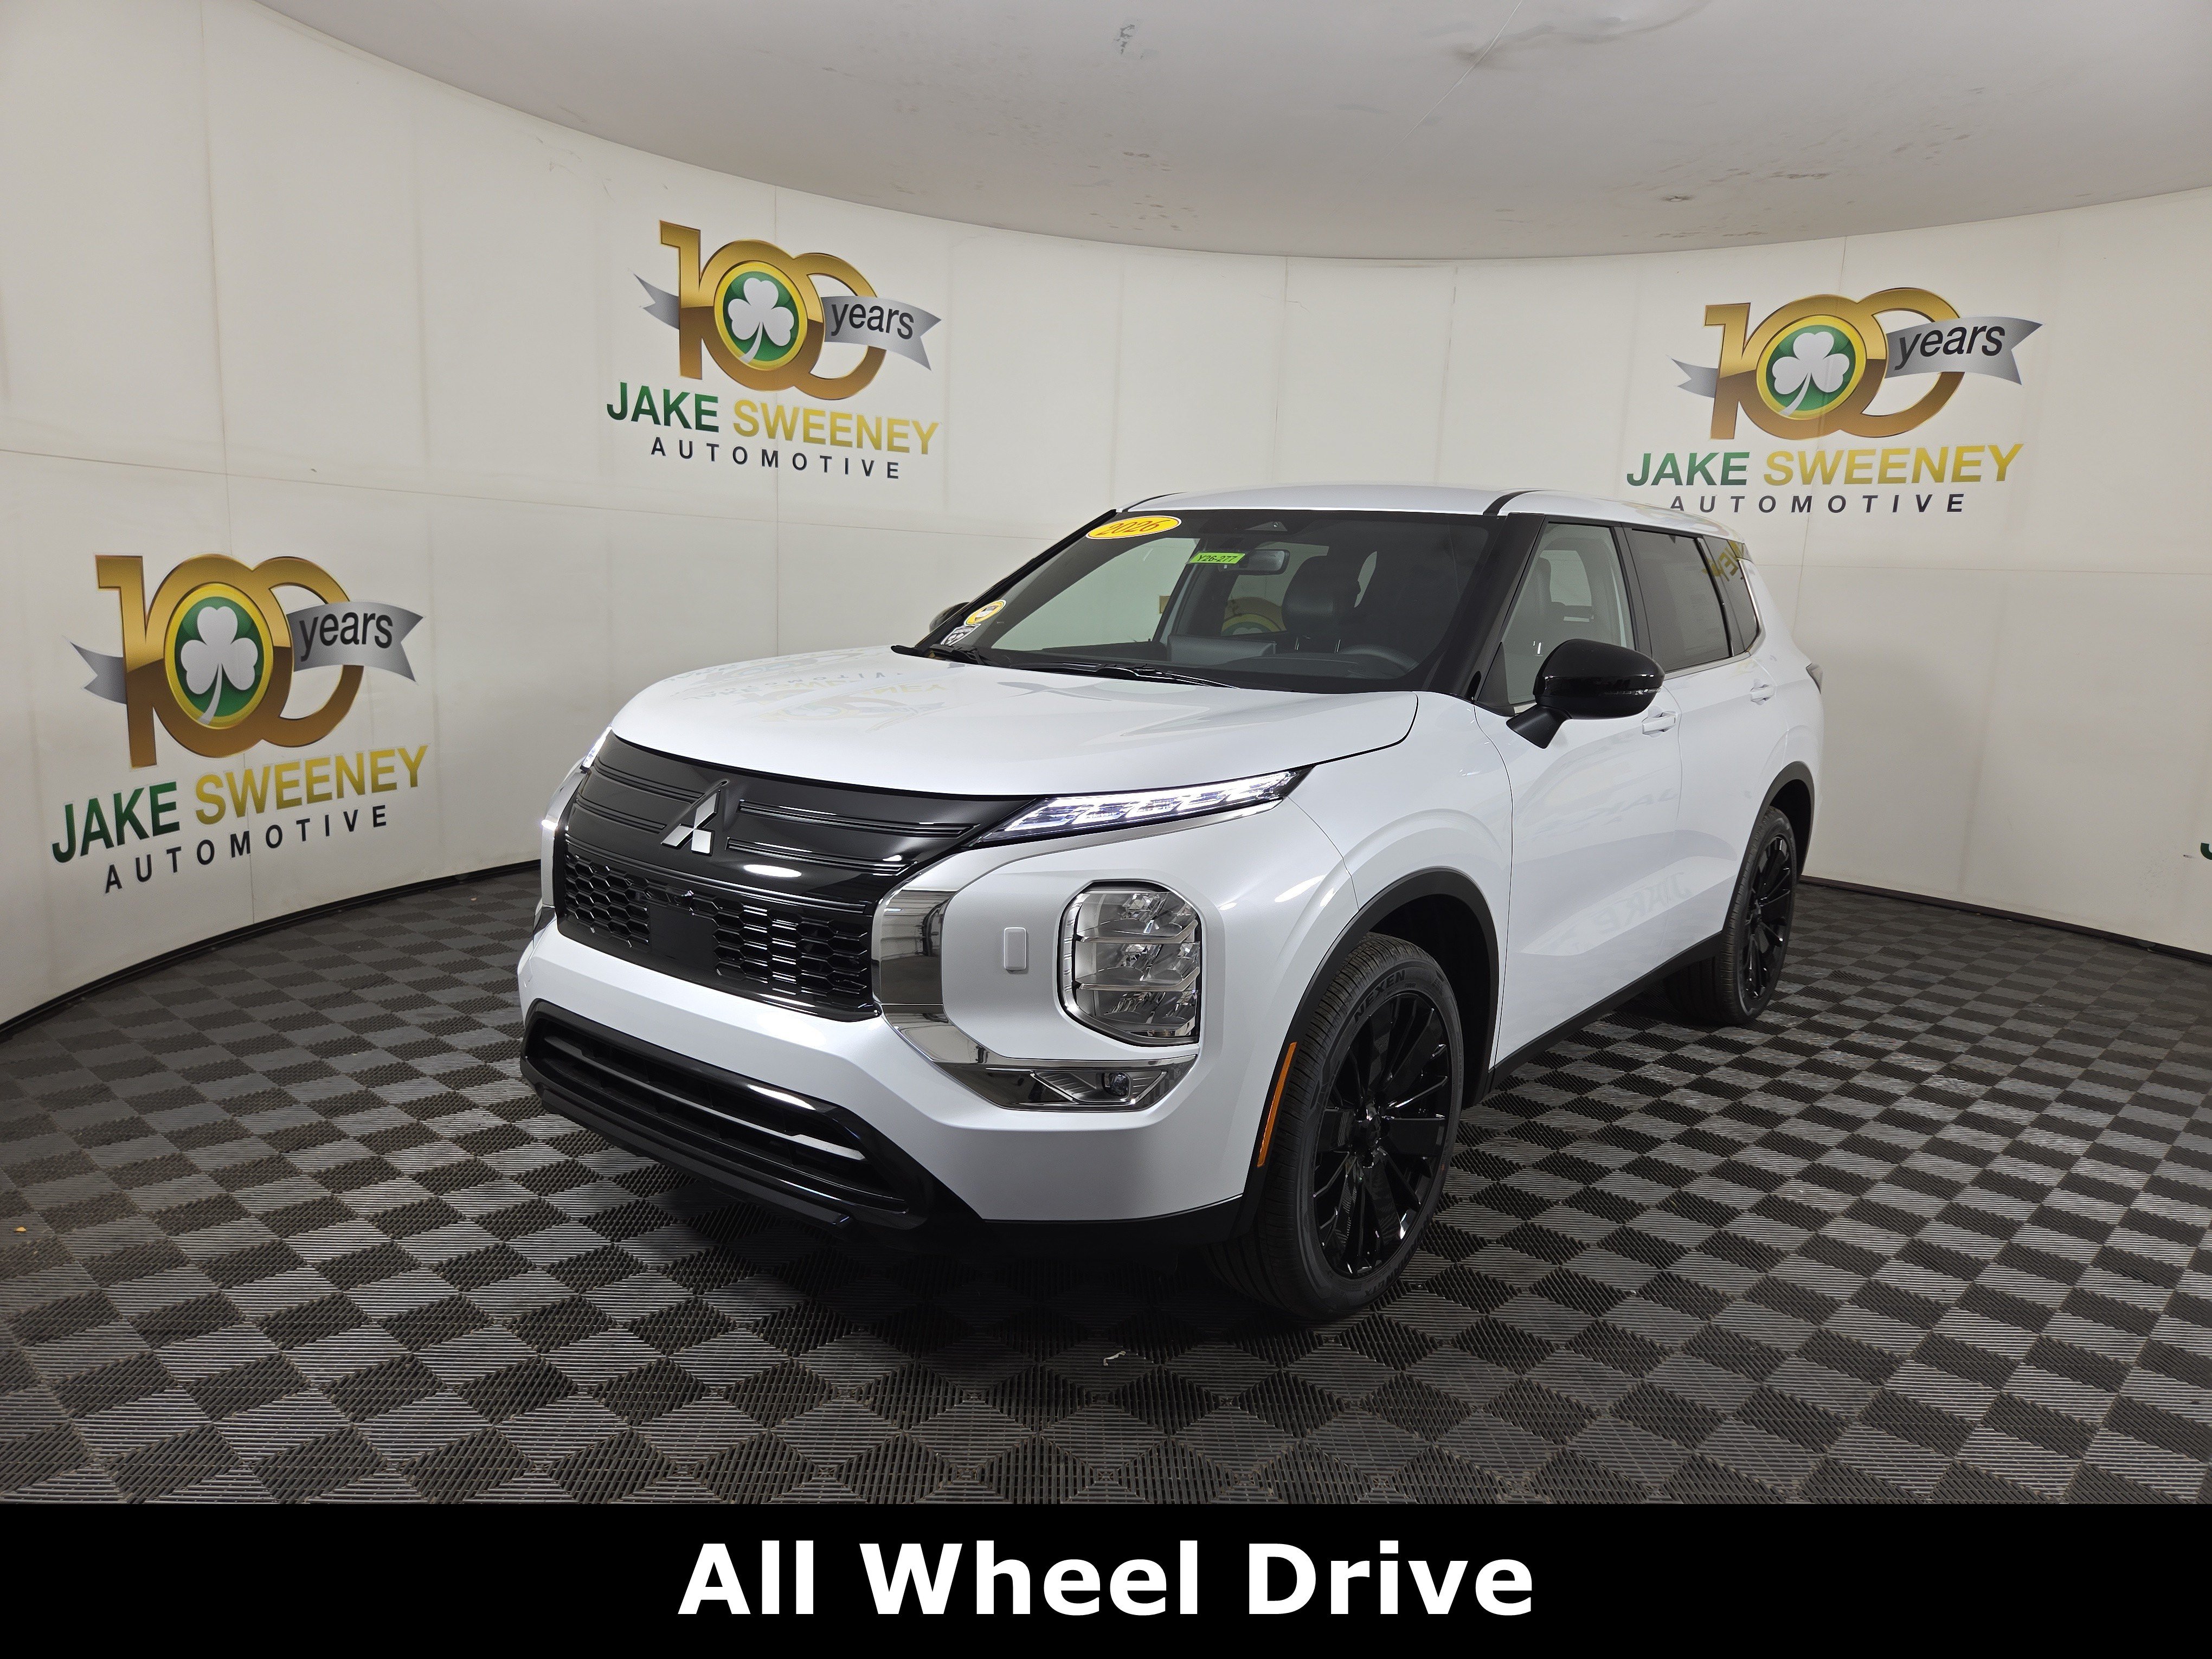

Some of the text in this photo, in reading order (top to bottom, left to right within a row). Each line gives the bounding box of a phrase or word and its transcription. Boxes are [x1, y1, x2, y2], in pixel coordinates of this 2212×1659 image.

[831, 300, 914, 340] years
[1894, 325, 2005, 370] years
[607, 382, 940, 455] JAKE SWEENEY
[651, 436, 899, 479] AUTOMOTIVE
[1626, 443, 2024, 486] JAKE SWEENEY
[1670, 493, 1965, 513] AUTOMOTIVE
[1095, 520, 1172, 536] 2026
[299, 612, 393, 661] years
[52, 744, 428, 864] JAKE SWEENEY
[105, 805, 387, 893] AUTOMOTIVE
[1354, 969, 1405, 1019] NEXEN
